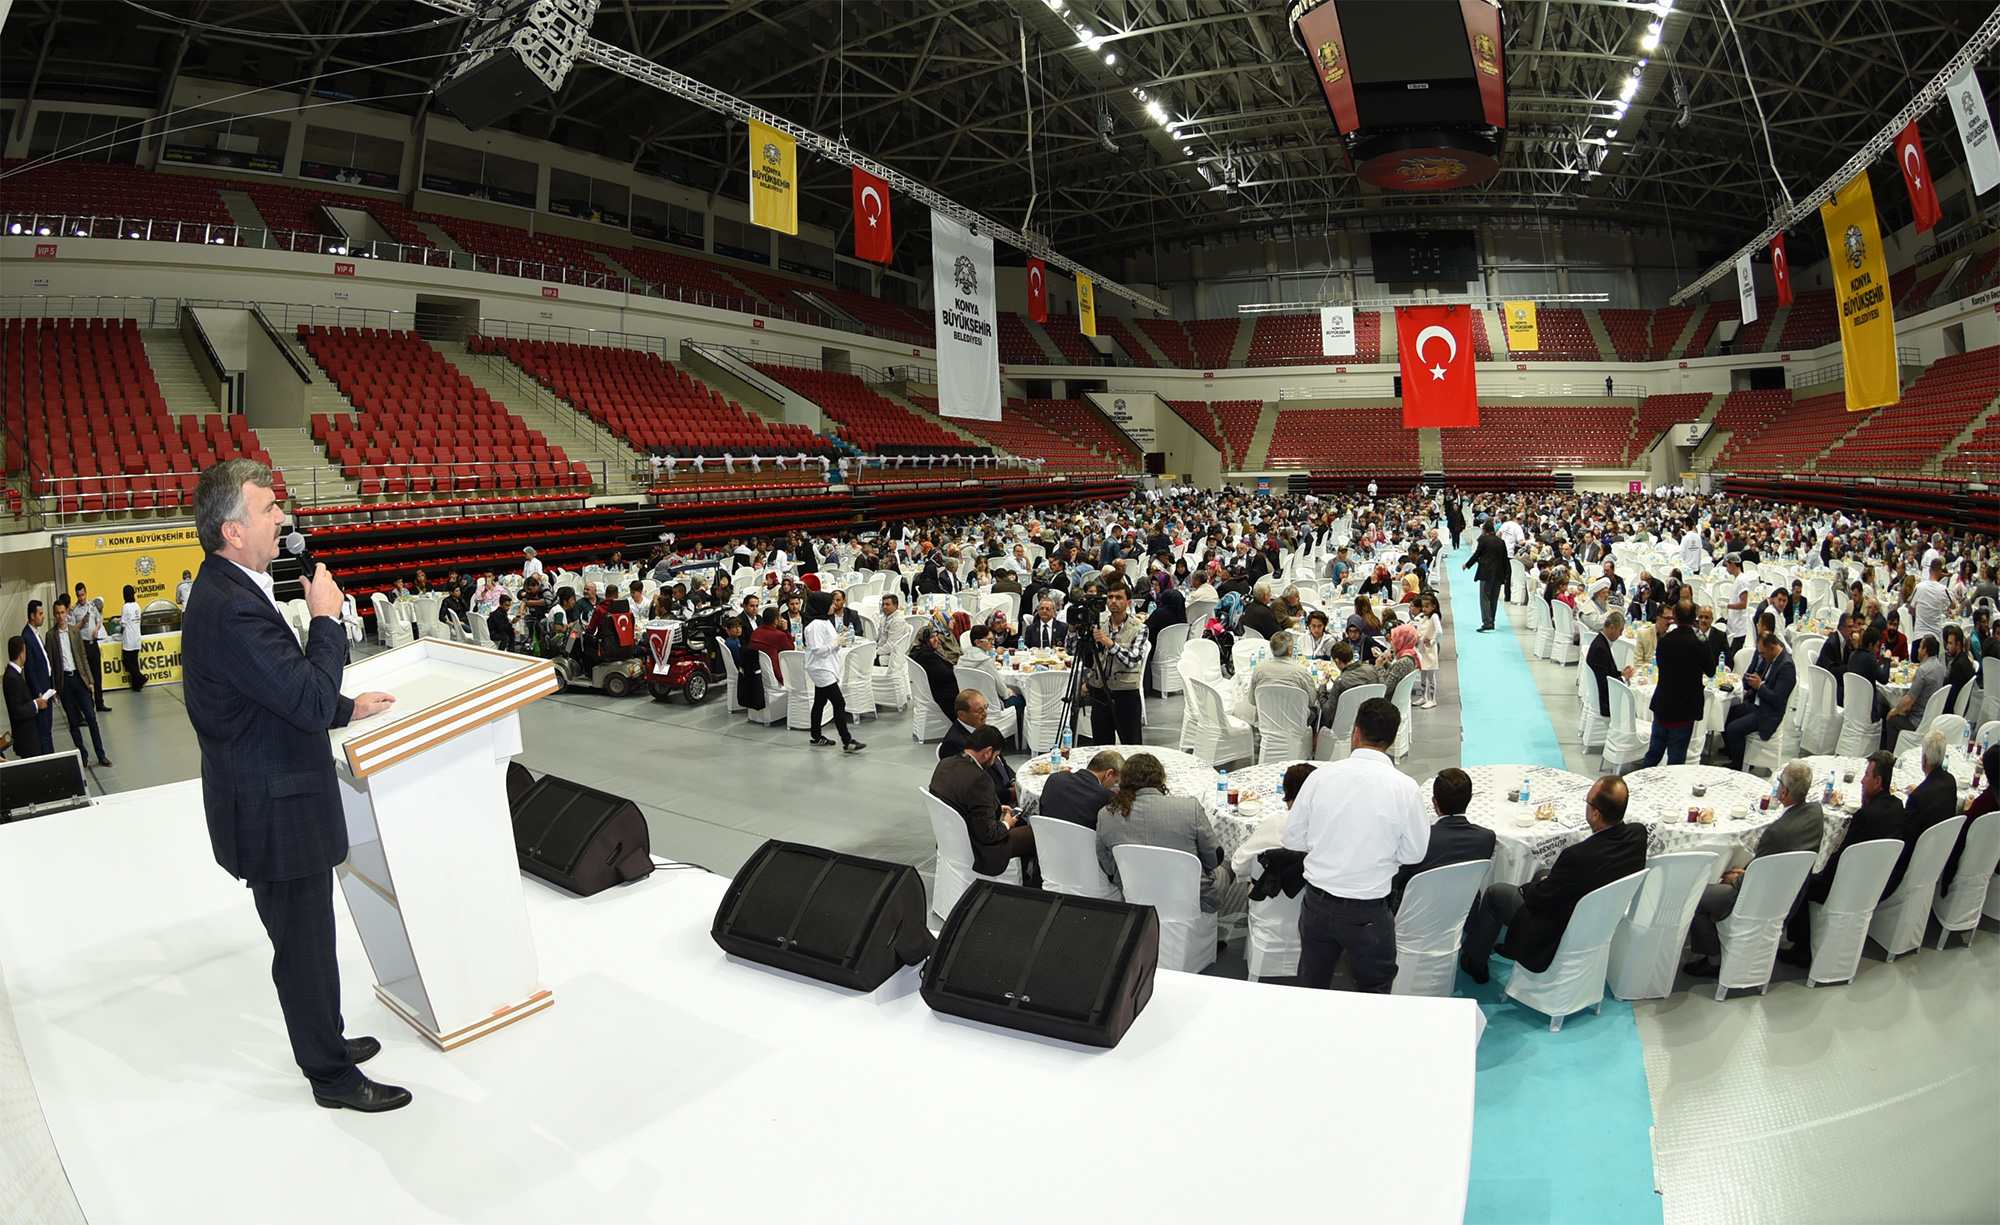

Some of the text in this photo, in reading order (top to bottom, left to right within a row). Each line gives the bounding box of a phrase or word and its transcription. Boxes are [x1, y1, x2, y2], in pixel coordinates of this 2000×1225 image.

[752, 169, 790, 190] BÜYÜKŞEHİR
[762, 165, 781, 177] KONYA
[37, 247, 55, 255] VIP 5
[1850, 271, 1872, 293] KONYA
[955, 297, 979, 316] KONYA
[1843, 282, 1885, 317] BÜYÜKŞEHİR
[942, 308, 991, 337] BÜYÜKŞEHİR
[1854, 306, 1879, 327] BELEDİYESİ
[953, 330, 982, 346] BELEDİYESİ
[109, 531, 199, 545] KONYA BÜYÜKŞEHİR BEL
[133, 583, 165, 594] ÜYÜKŞEHİR
[140, 641, 164, 653] NYA
[103, 651, 182, 674] BÜKŞEHİ
[121, 668, 172, 683] BEDİYESİ
